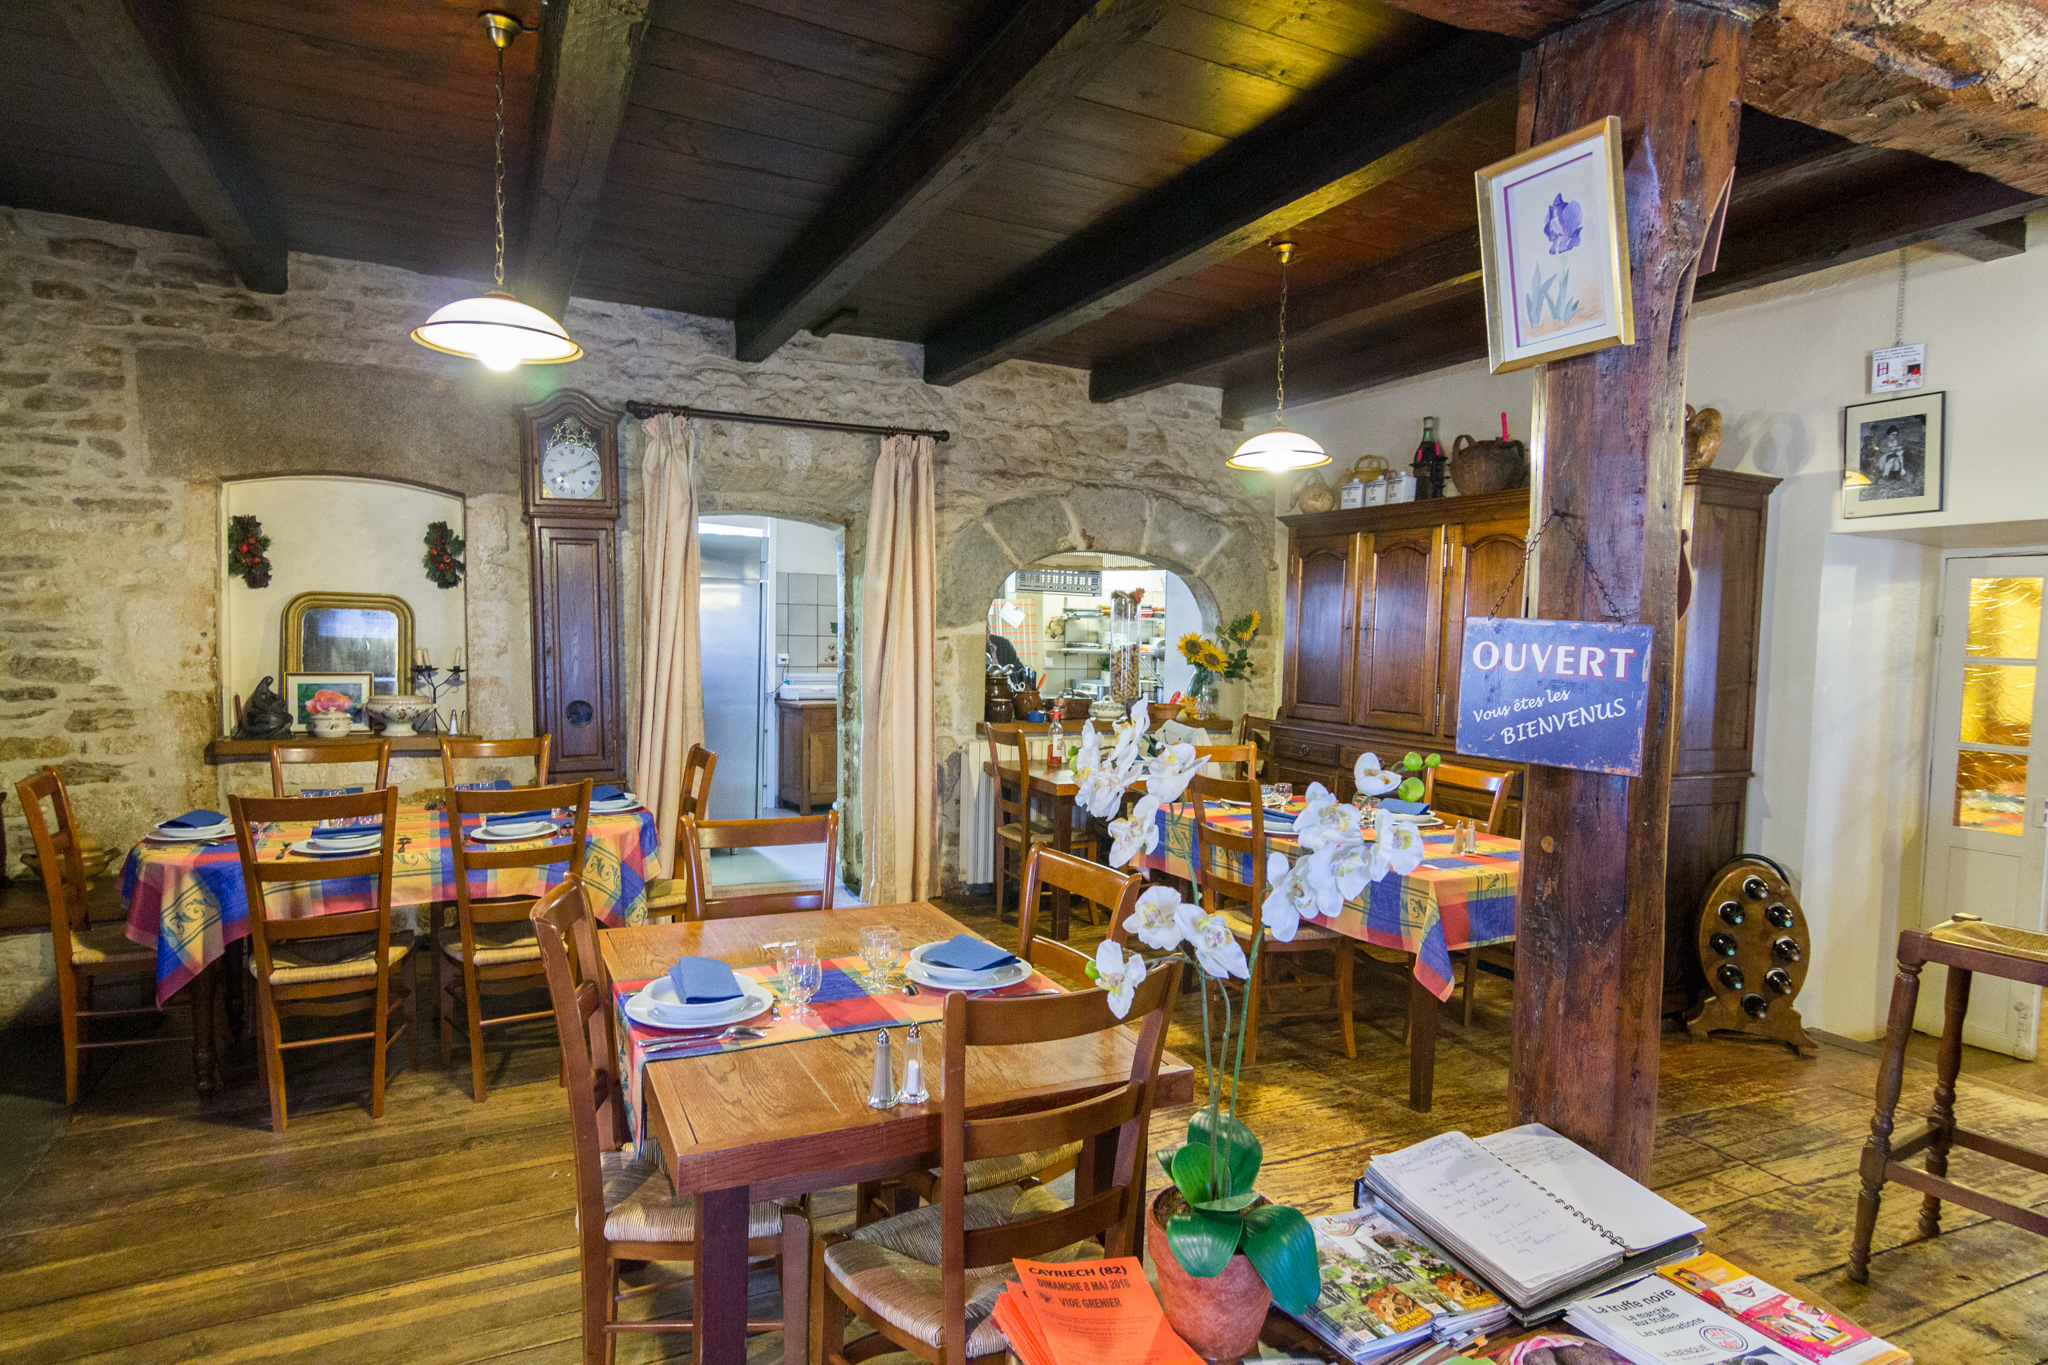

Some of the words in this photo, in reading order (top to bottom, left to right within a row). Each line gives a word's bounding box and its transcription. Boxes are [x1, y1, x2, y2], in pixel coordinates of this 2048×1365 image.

[1472, 640, 1637, 681] OUVERT
[1473, 704, 1511, 723] Vous
[1513, 696, 1545, 713] êtes
[1545, 689, 1571, 704] les
[1500, 698, 1627, 745] BIENVENUS
[1028, 1266, 1096, 1278] CAYRIECH
[1099, 1265, 1127, 1277] (82)
[1036, 1278, 1082, 1292] DIMANCHE
[1091, 1279, 1109, 1291] MAI
[1110, 1278, 1131, 1290] 2016
[1058, 1296, 1082, 1309] VIDE
[1082, 1297, 1123, 1309] GRENIER
[1587, 1304, 1607, 1315] La
[1605, 1299, 1644, 1313] truffe
[1642, 1288, 1676, 1305] noire
[1622, 1314, 1636, 1322] Le
[1637, 1306, 1671, 1320] marché
[1632, 1318, 1651, 1327] aux
[1650, 1311, 1680, 1324] truffes
[1636, 1328, 1657, 1338] Les
[1657, 1317, 1706, 1336] animations
